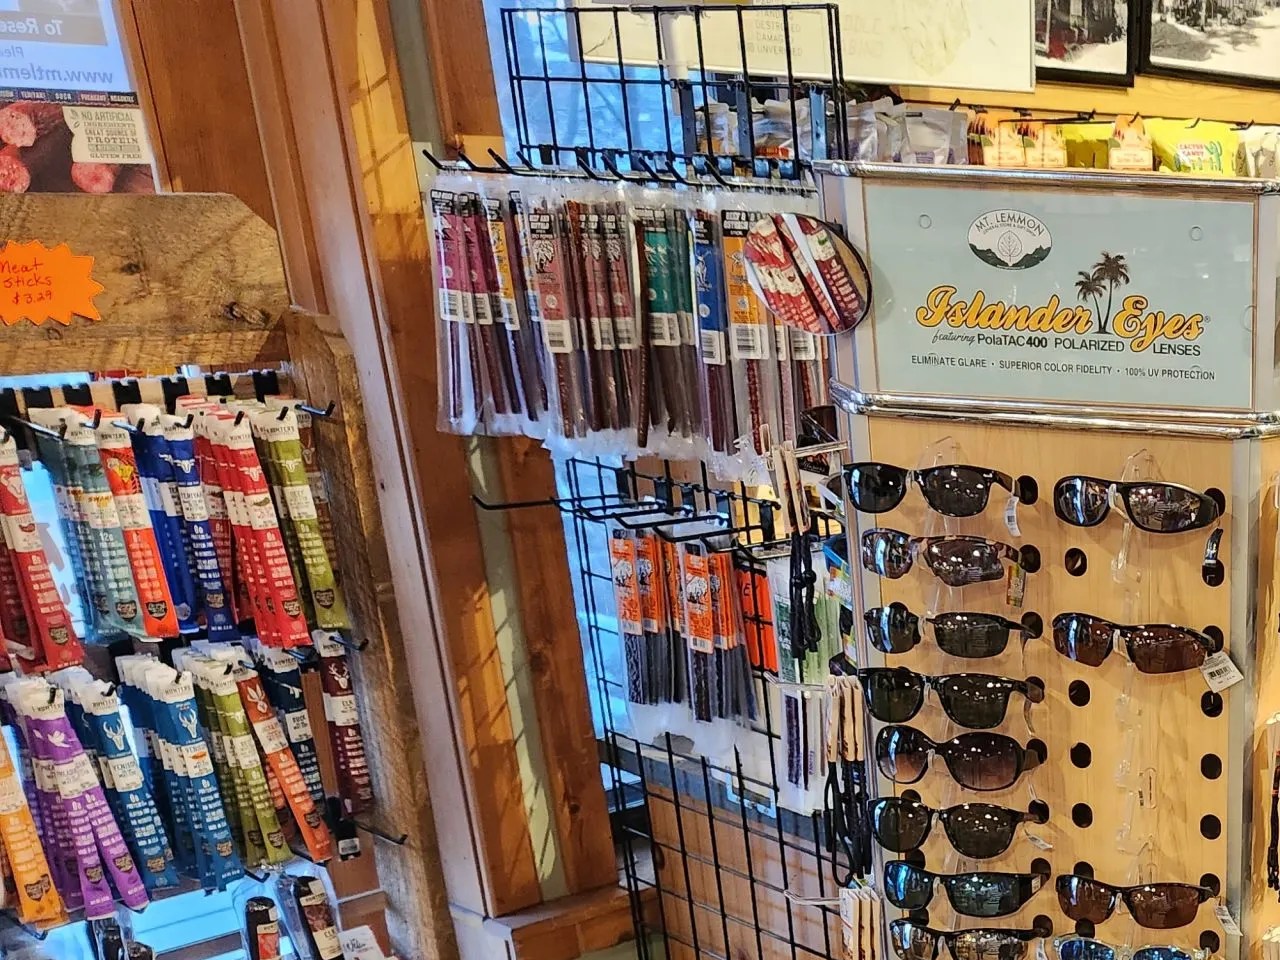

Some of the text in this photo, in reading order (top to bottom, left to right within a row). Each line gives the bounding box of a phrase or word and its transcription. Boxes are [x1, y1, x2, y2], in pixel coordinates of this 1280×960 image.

[81, 111, 135, 121] NO ARTIFICIAL
[975, 212, 1045, 236] MT. LEMMON
[916, 285, 1204, 352] Islander Eyes
[932, 329, 976, 346] featuring
[1054, 337, 1125, 352] POLARIZED
[1153, 343, 1201, 356] LENSES
[911, 355, 1215, 381] ELIMINATE GLARE SUPERIOR COLOR FIDELITY 100% UV PROTECTION
